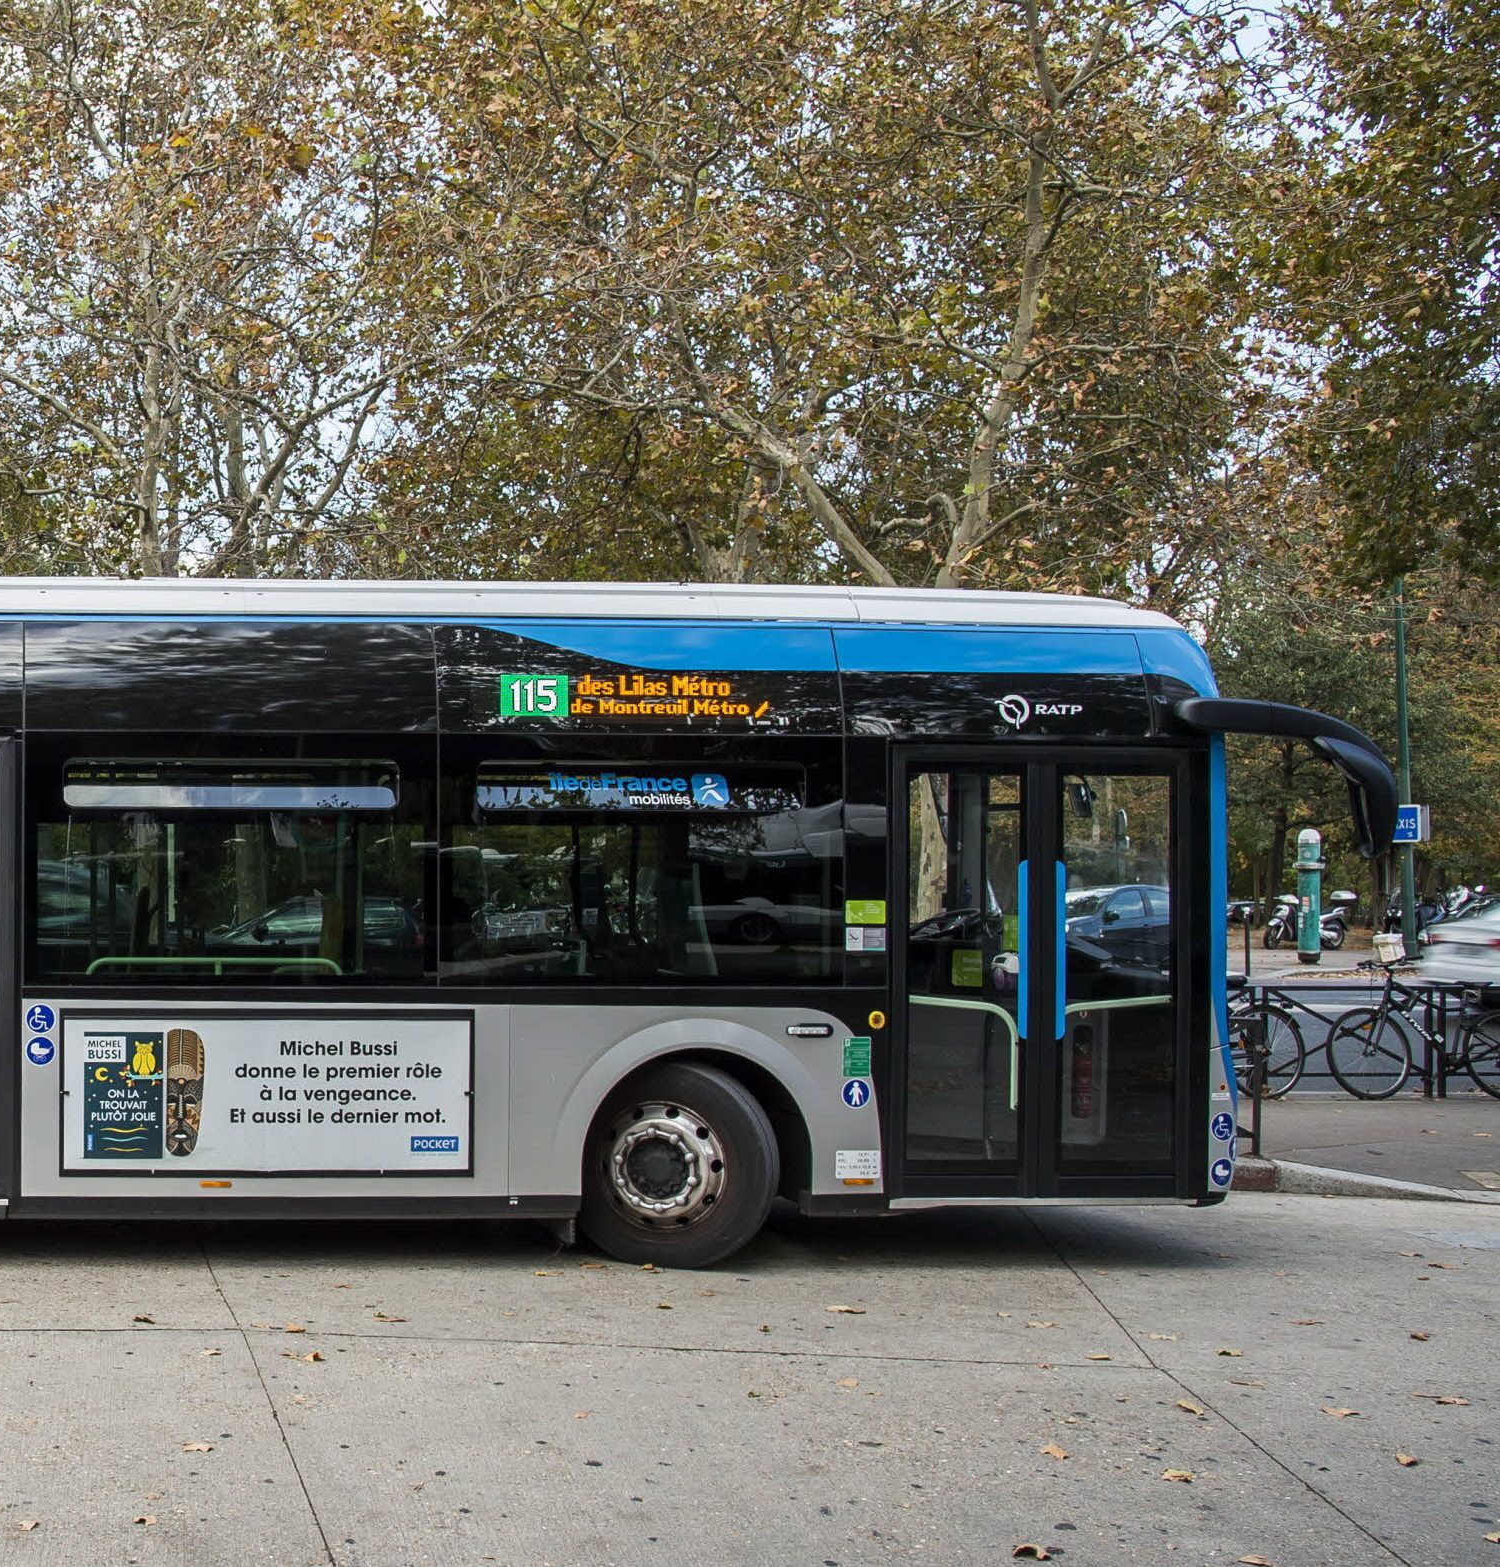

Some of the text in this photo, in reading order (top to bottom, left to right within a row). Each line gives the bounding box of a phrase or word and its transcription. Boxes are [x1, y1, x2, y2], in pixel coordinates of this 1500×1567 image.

[577, 675, 730, 696] des Lilas Métro
[511, 680, 556, 711] 115
[571, 699, 750, 715] de Montreuil Métro
[1035, 705, 1082, 714] RATP
[629, 793, 692, 807] mobilités
[89, 1050, 120, 1059] BUSSI
[281, 1041, 397, 1056] Michel Bussi
[235, 1063, 441, 1081] donne le premier rôle
[107, 1089, 139, 1098] ON LA
[260, 1085, 416, 1105] à la vengeance.
[100, 1101, 147, 1109] TROUVAIT
[92, 1110, 155, 1121] PLUTÔT JOLIE
[231, 1109, 445, 1123] Et aussi le dernier mot.
